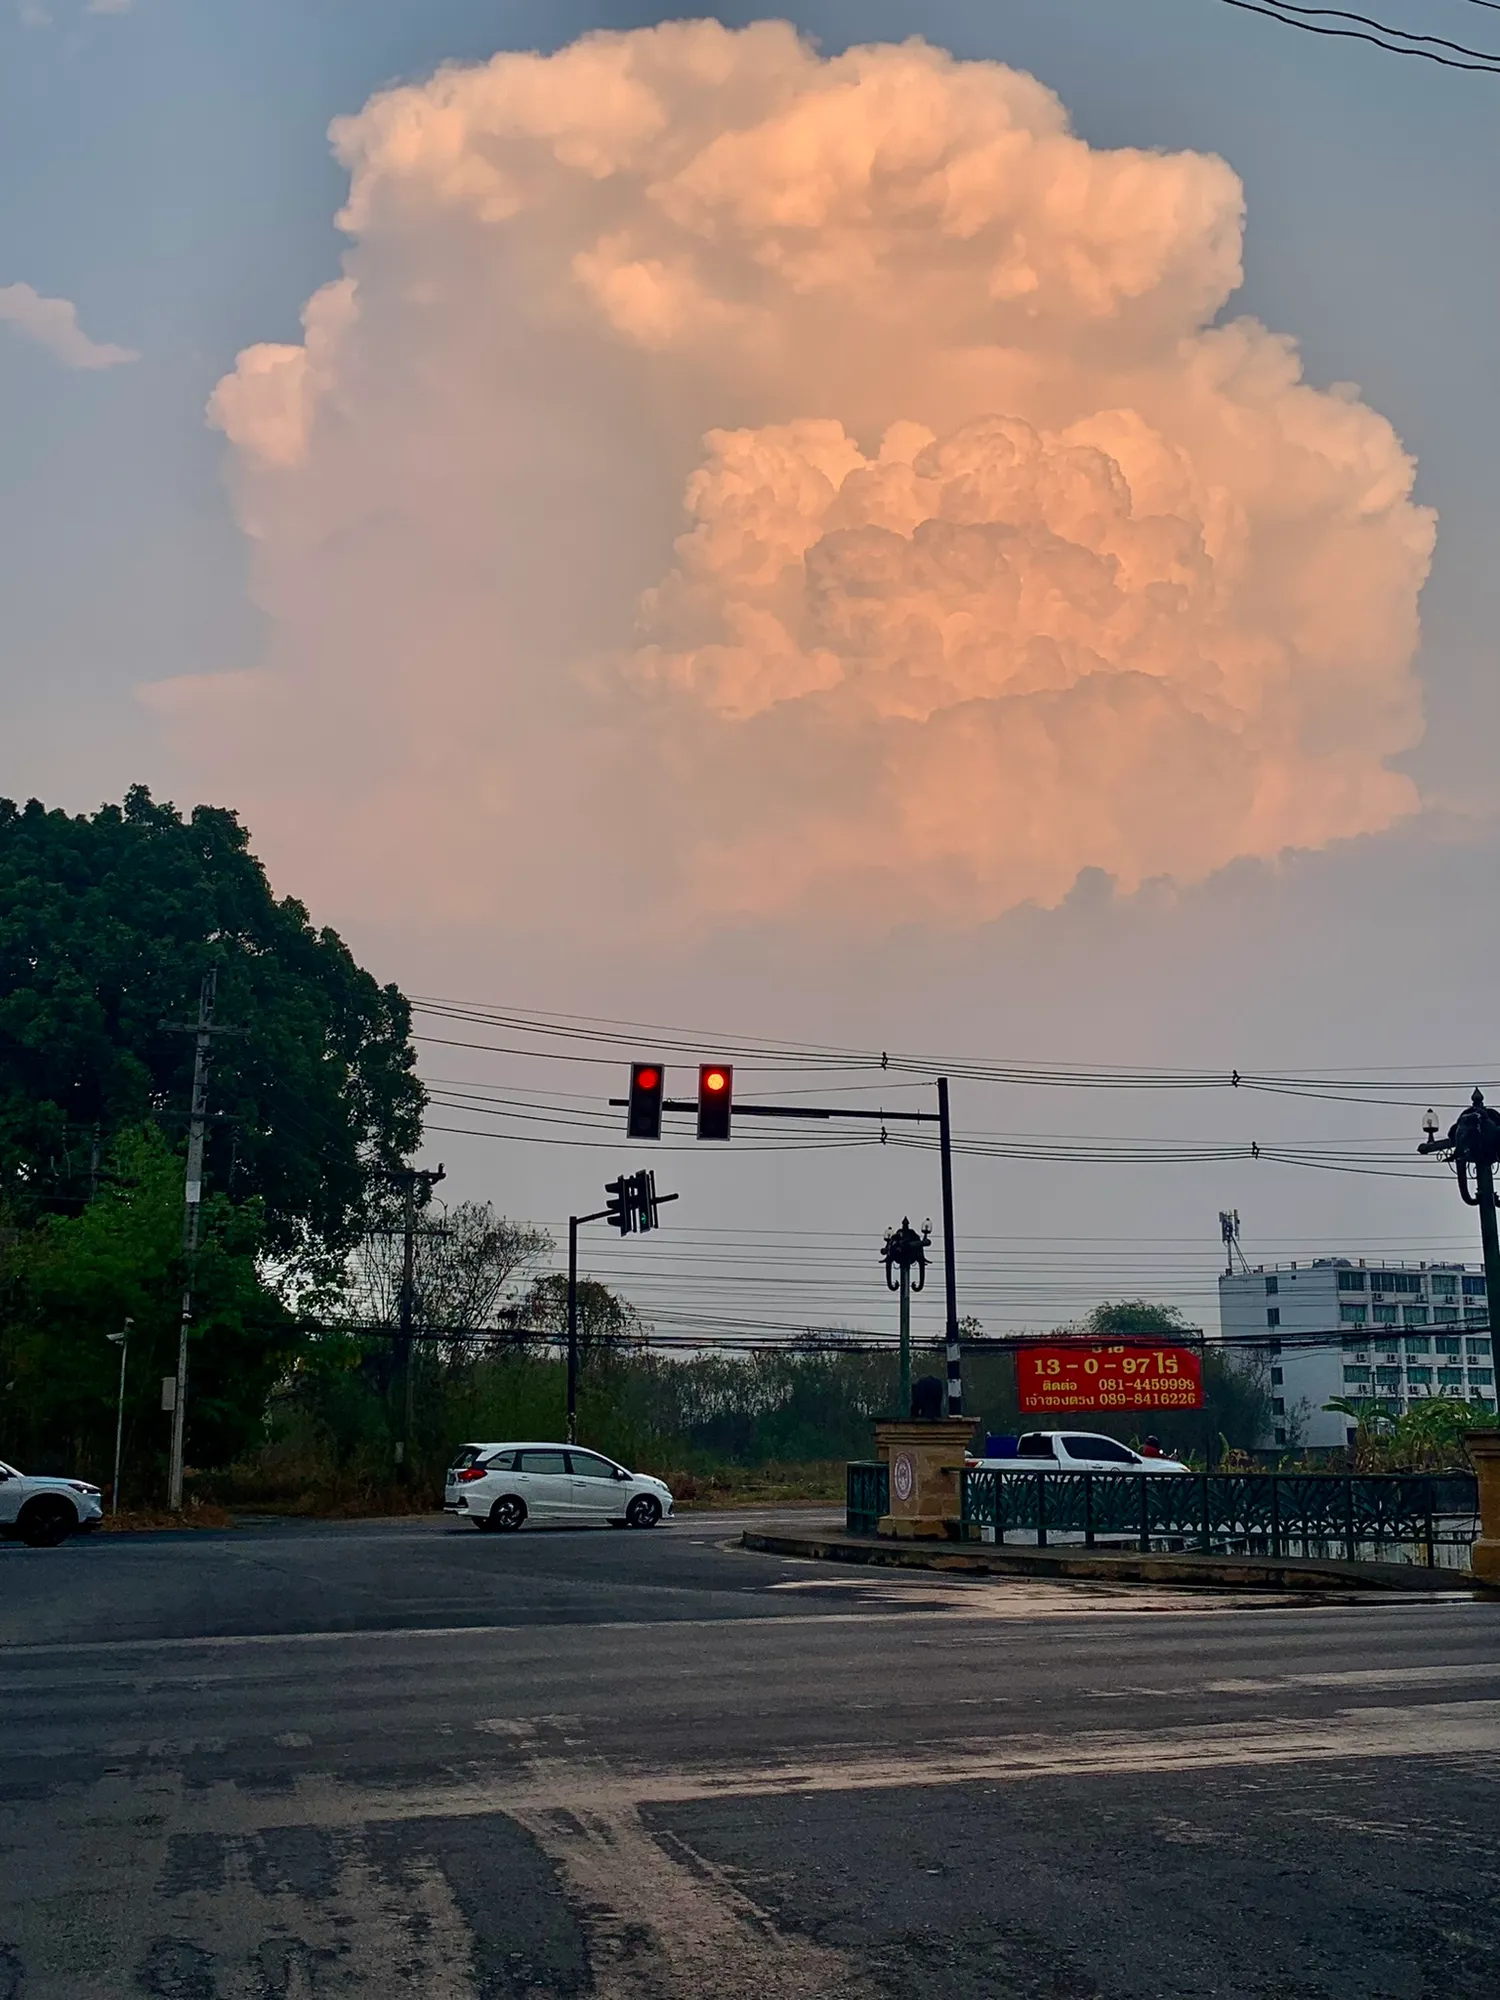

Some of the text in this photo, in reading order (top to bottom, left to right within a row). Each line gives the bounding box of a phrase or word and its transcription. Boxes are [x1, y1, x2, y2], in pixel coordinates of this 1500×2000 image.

[1034, 1358, 1061, 1375] 13
[1084, 1358, 1099, 1375] 0
[1122, 1358, 1150, 1374] 97
[1152, 1351, 1179, 1374] ไร่
[1042, 1378, 1195, 1391] ติดต่อ 081-4459999
[1025, 1393, 1196, 1406] เจ้าของตรง 089-8416226
